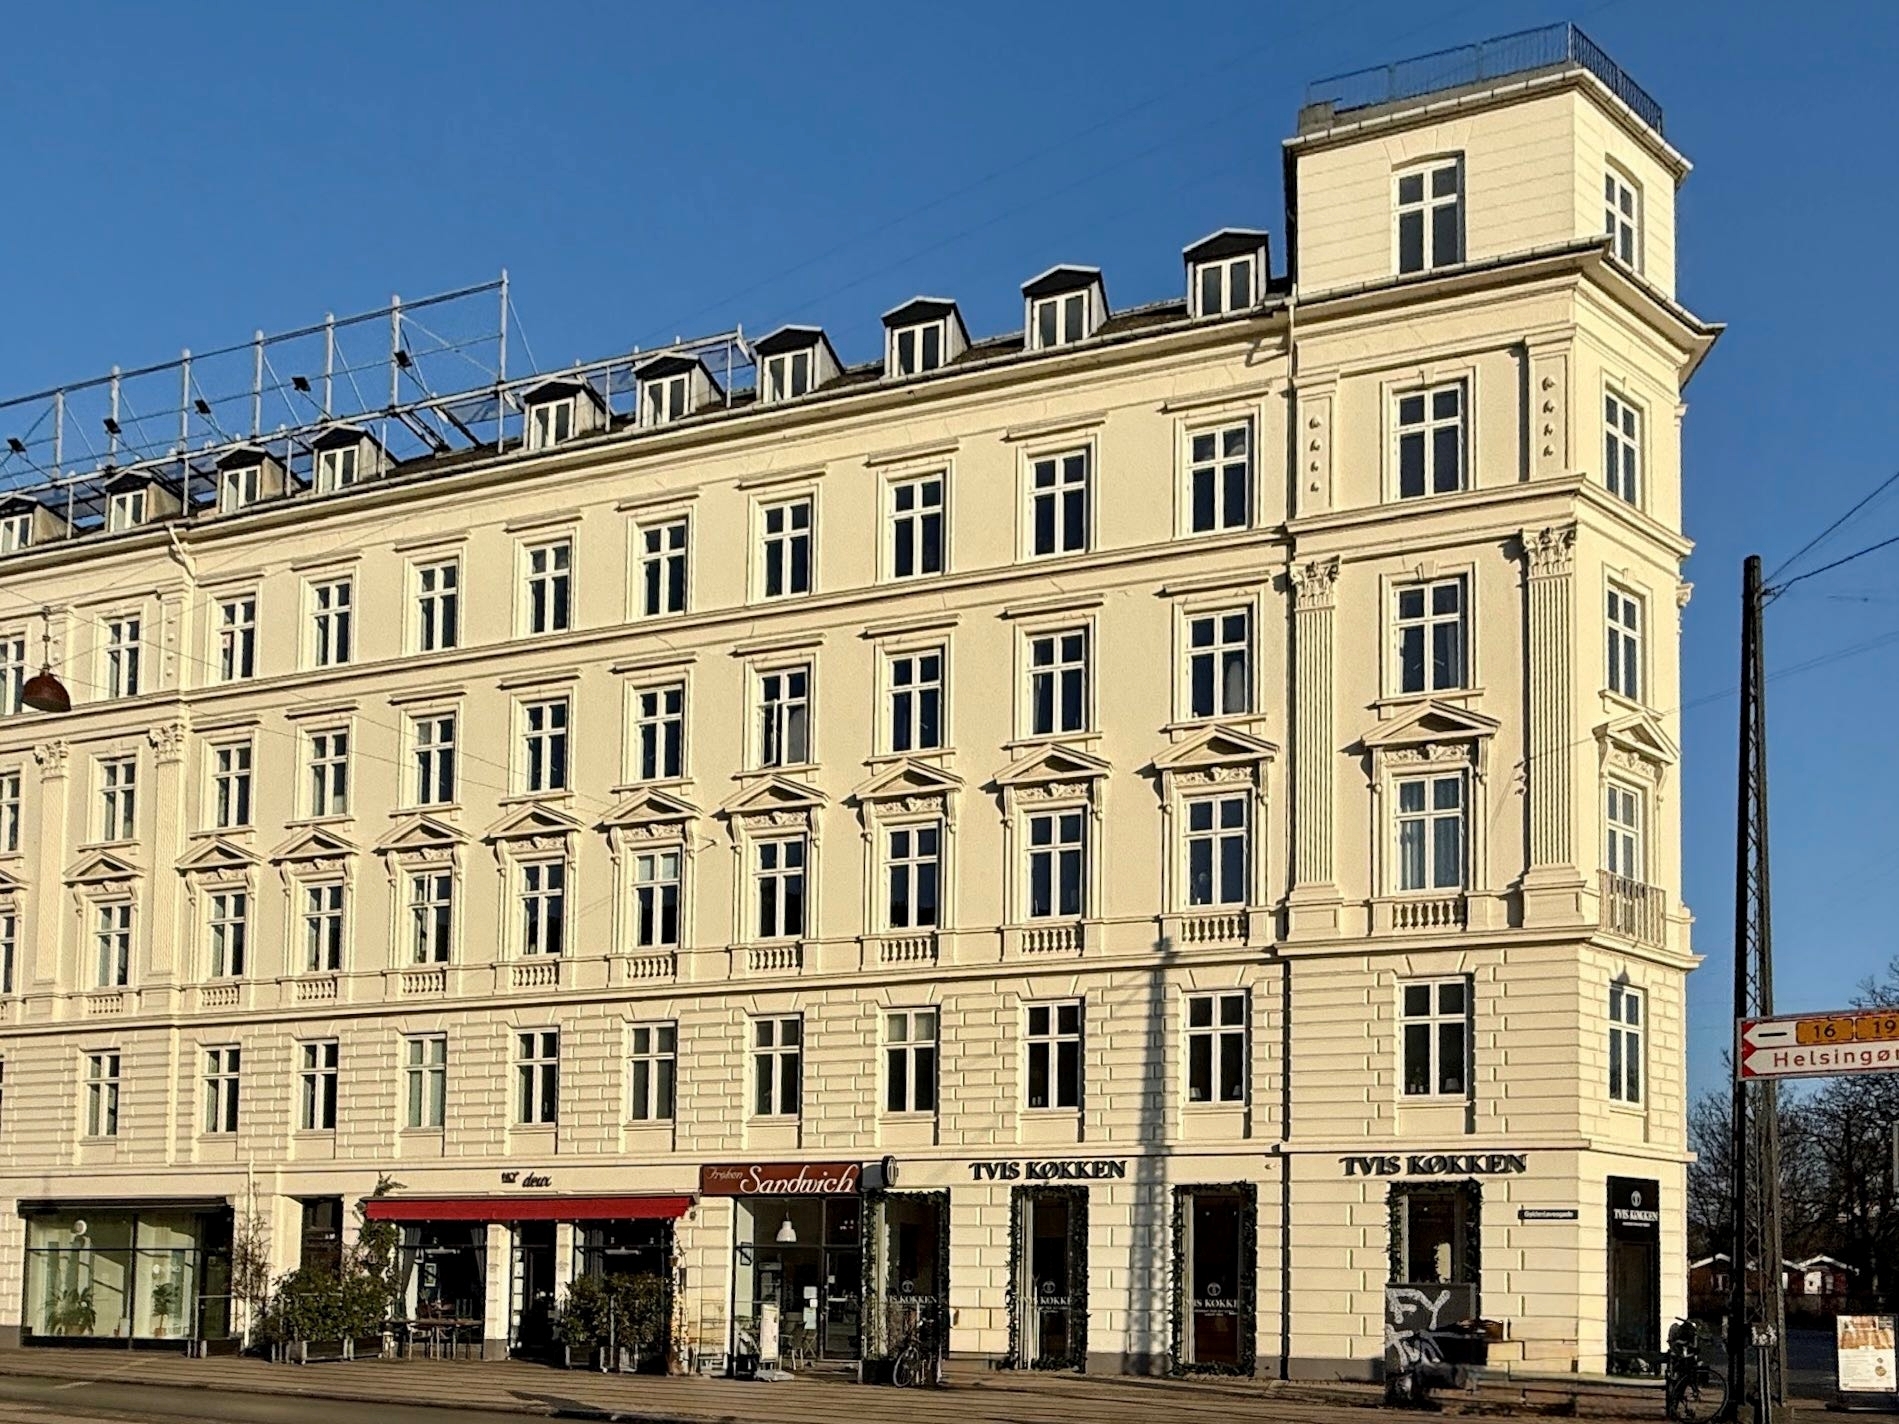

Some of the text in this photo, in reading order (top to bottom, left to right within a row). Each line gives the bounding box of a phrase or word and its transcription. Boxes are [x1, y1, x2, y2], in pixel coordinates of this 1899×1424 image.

[1813, 1023, 1836, 1039] 16
[1873, 1019, 1897, 1034] 19
[968, 1160, 1128, 1180] TVIS KØKKEN
[1338, 1153, 1528, 1177] TVIS KØKKEN
[739, 1163, 860, 1195] Sandwich
